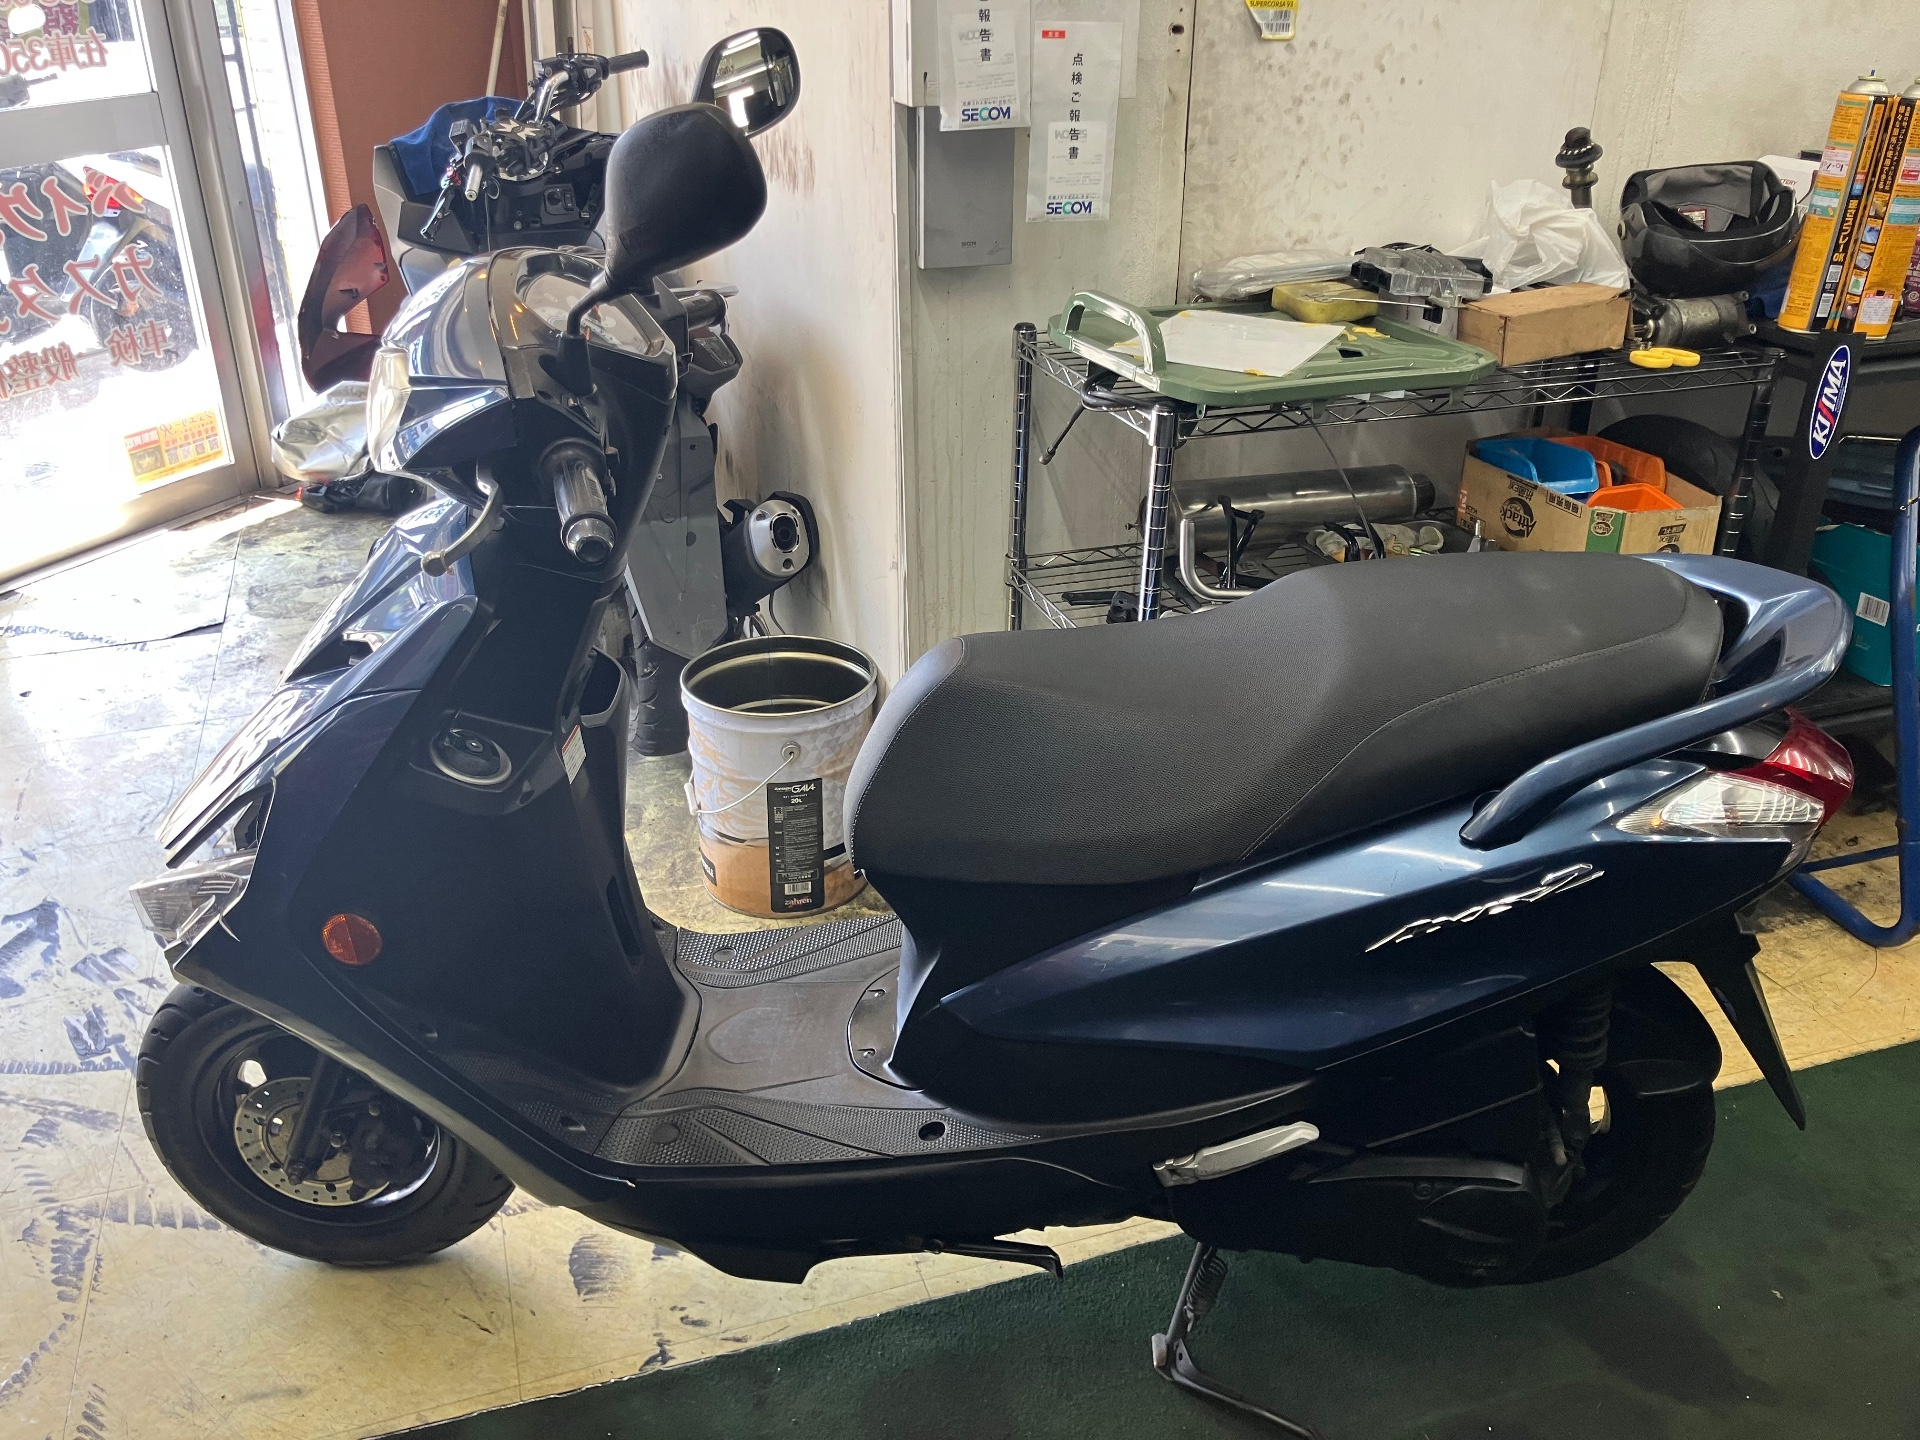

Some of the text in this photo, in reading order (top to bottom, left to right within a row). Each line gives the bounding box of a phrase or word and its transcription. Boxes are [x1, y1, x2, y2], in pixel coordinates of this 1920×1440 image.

[978, 0, 992, 61] 報告書
[961, 106, 1011, 122] SECOM
[1068, 52, 1084, 160] 点検ご報告書
[1046, 201, 1093, 215] SECOM
[1501, 506, 1537, 538] Attack
